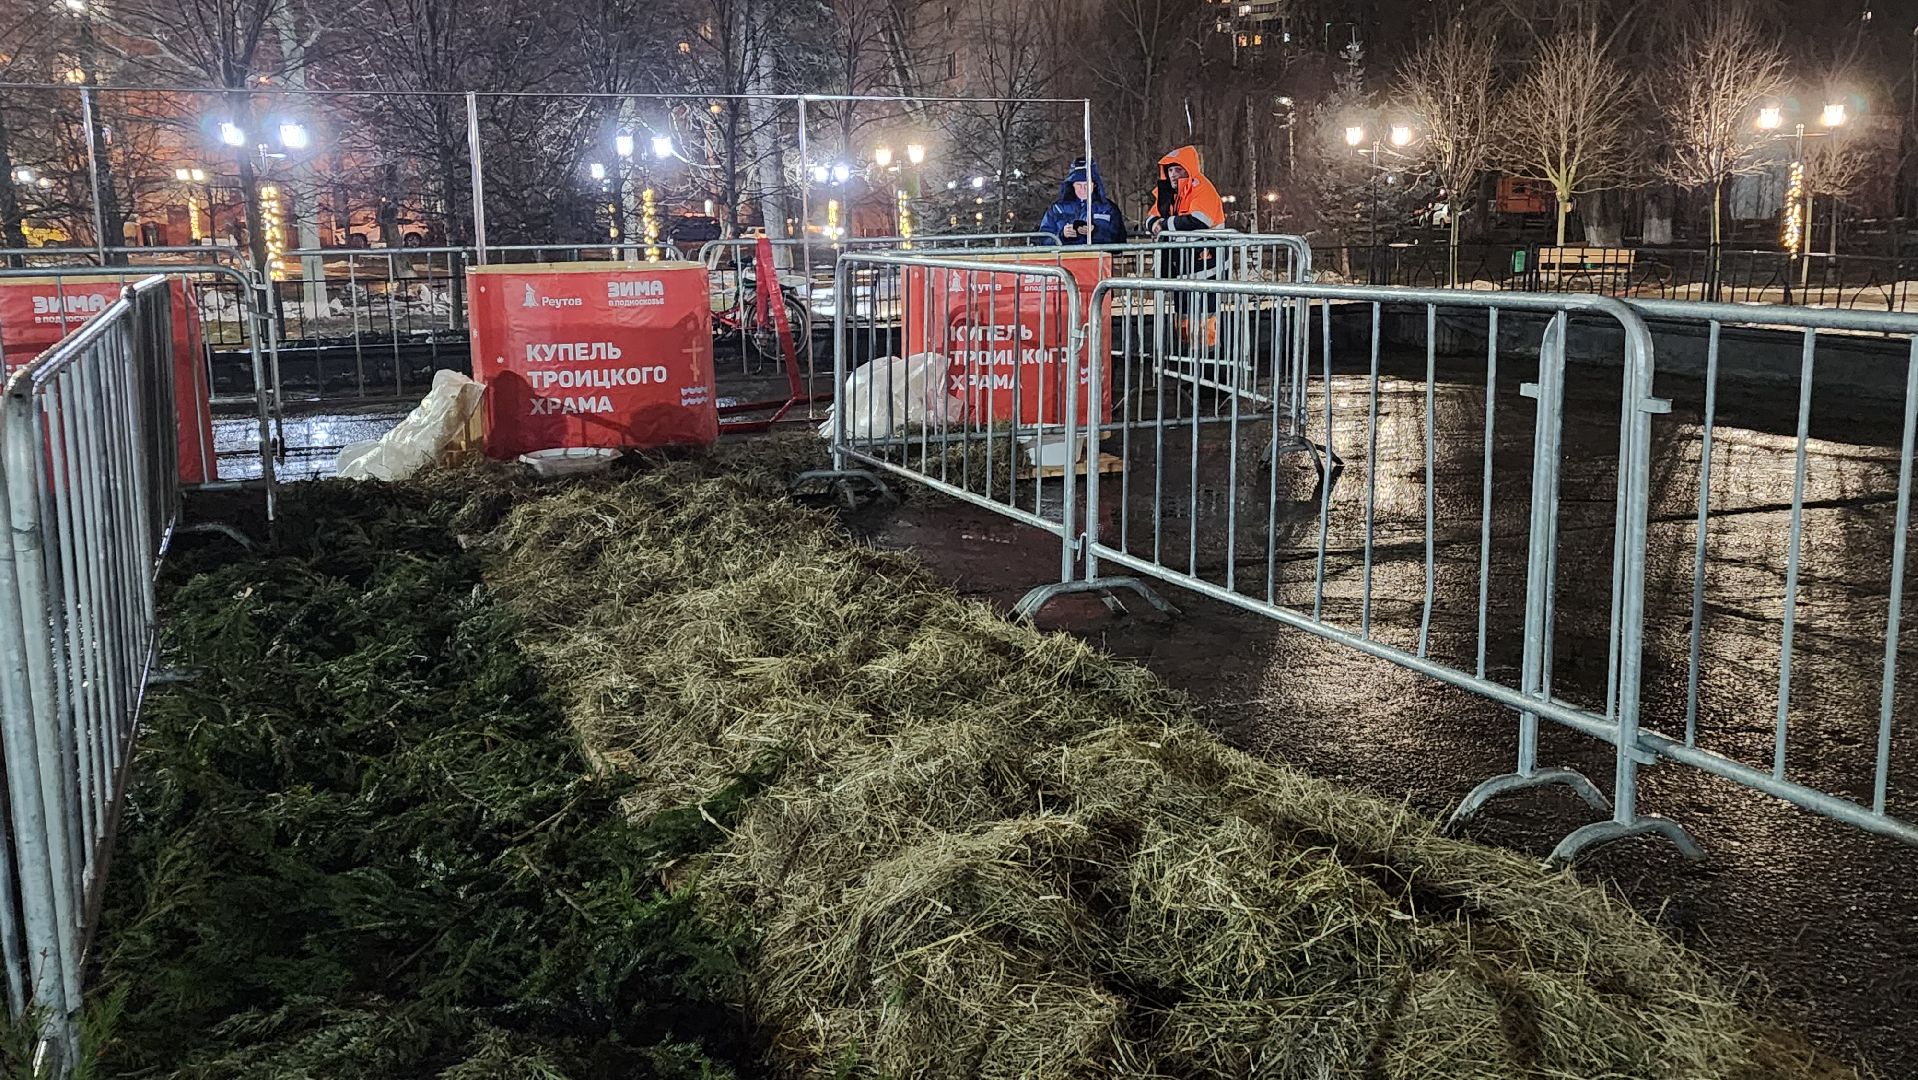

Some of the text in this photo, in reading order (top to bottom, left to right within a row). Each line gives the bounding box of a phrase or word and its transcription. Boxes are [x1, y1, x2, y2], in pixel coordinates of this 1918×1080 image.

[607, 280, 664, 298] ЗИМА
[32, 294, 106, 314] ЗИМА
[541, 296, 583, 308] Реутов
[950, 324, 1033, 342] КУПЕЛЬ
[526, 342, 622, 362] КУПЕЛЬ
[527, 366, 667, 389] ТРОИЦКОГО
[530, 396, 614, 416] ХРАМА
